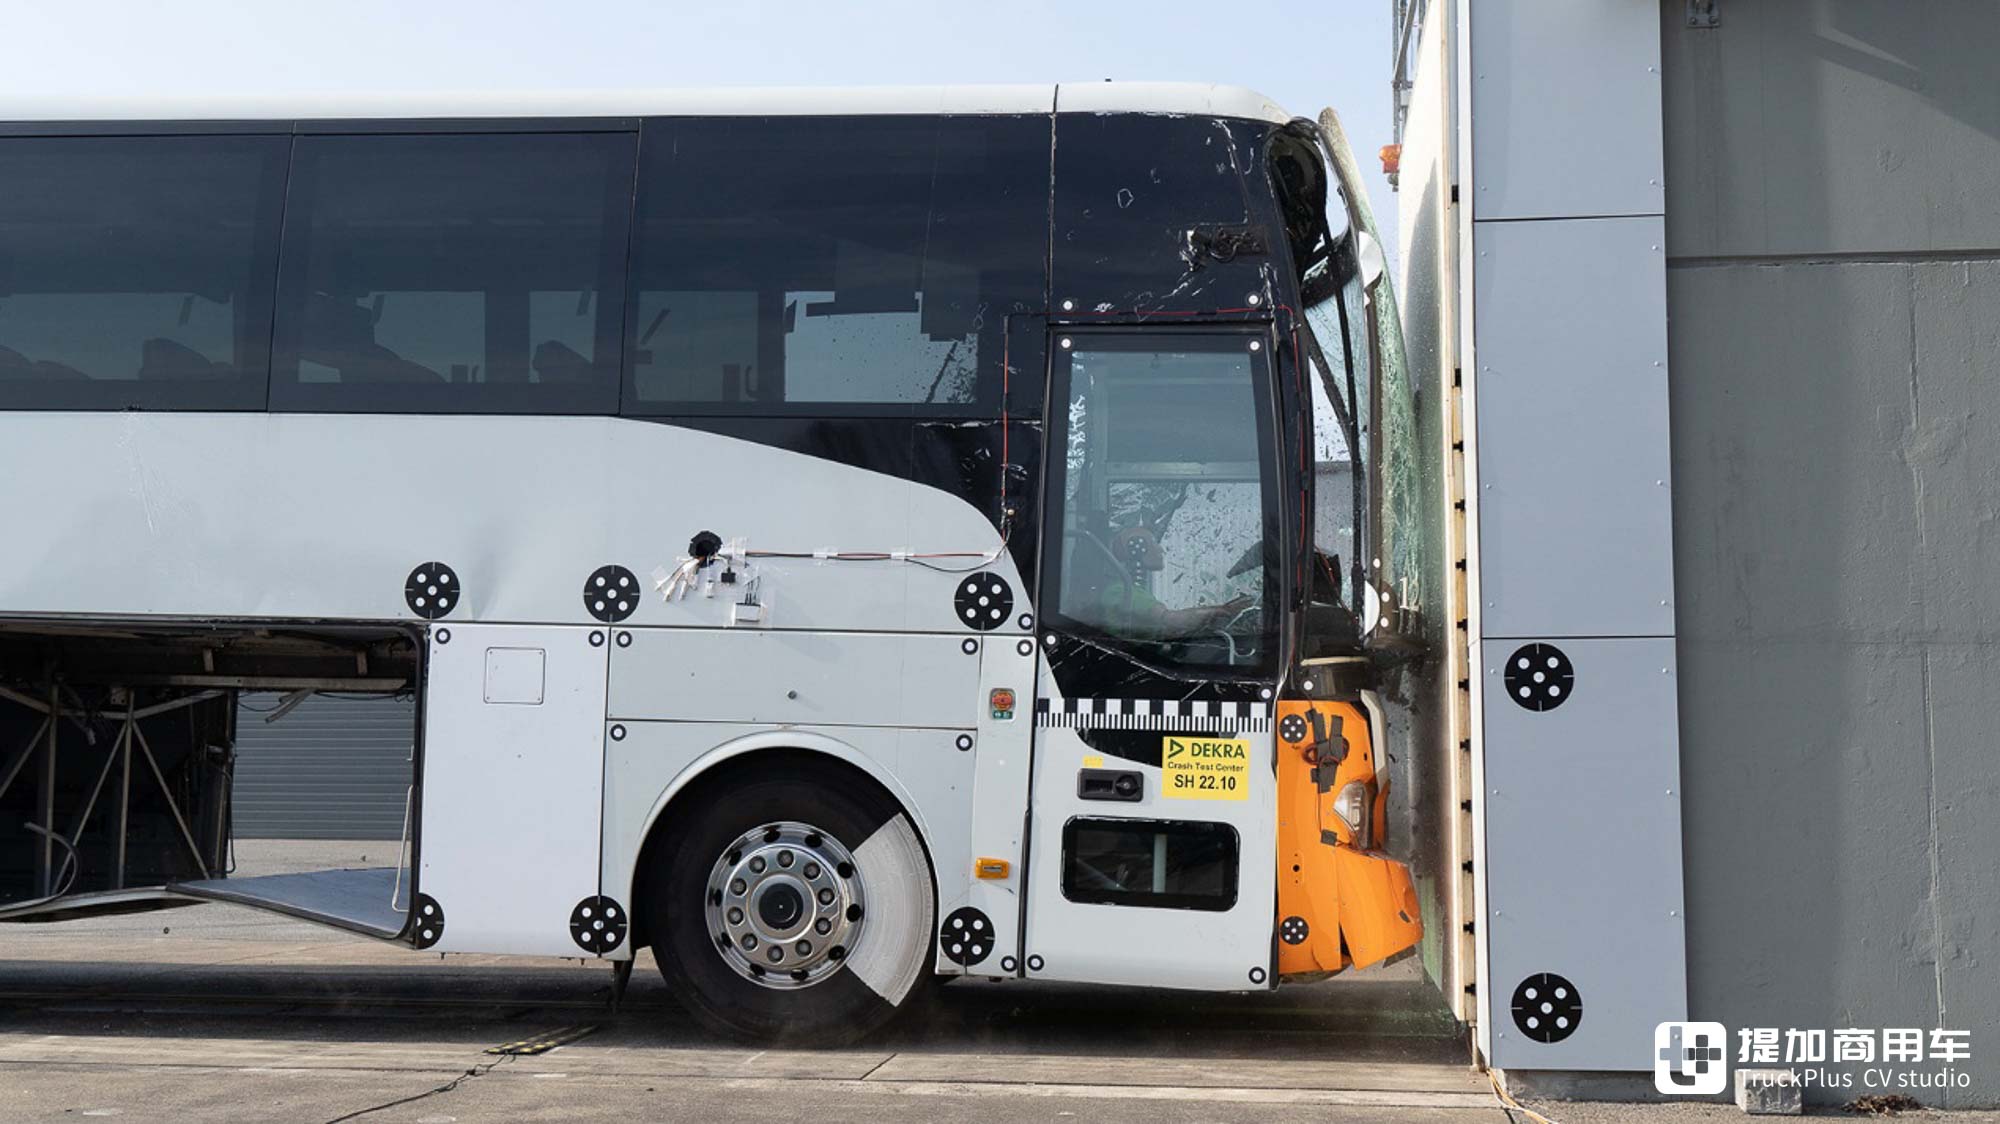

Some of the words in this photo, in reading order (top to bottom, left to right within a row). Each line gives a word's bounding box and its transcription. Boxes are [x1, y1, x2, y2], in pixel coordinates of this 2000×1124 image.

[1191, 742, 1245, 759] DEKRA
[1168, 761, 1193, 770] Crash
[1195, 762, 1214, 771] Test
[1215, 763, 1244, 772] Center
[1174, 774, 1195, 789] SH
[1199, 775, 1236, 791] 22.10
